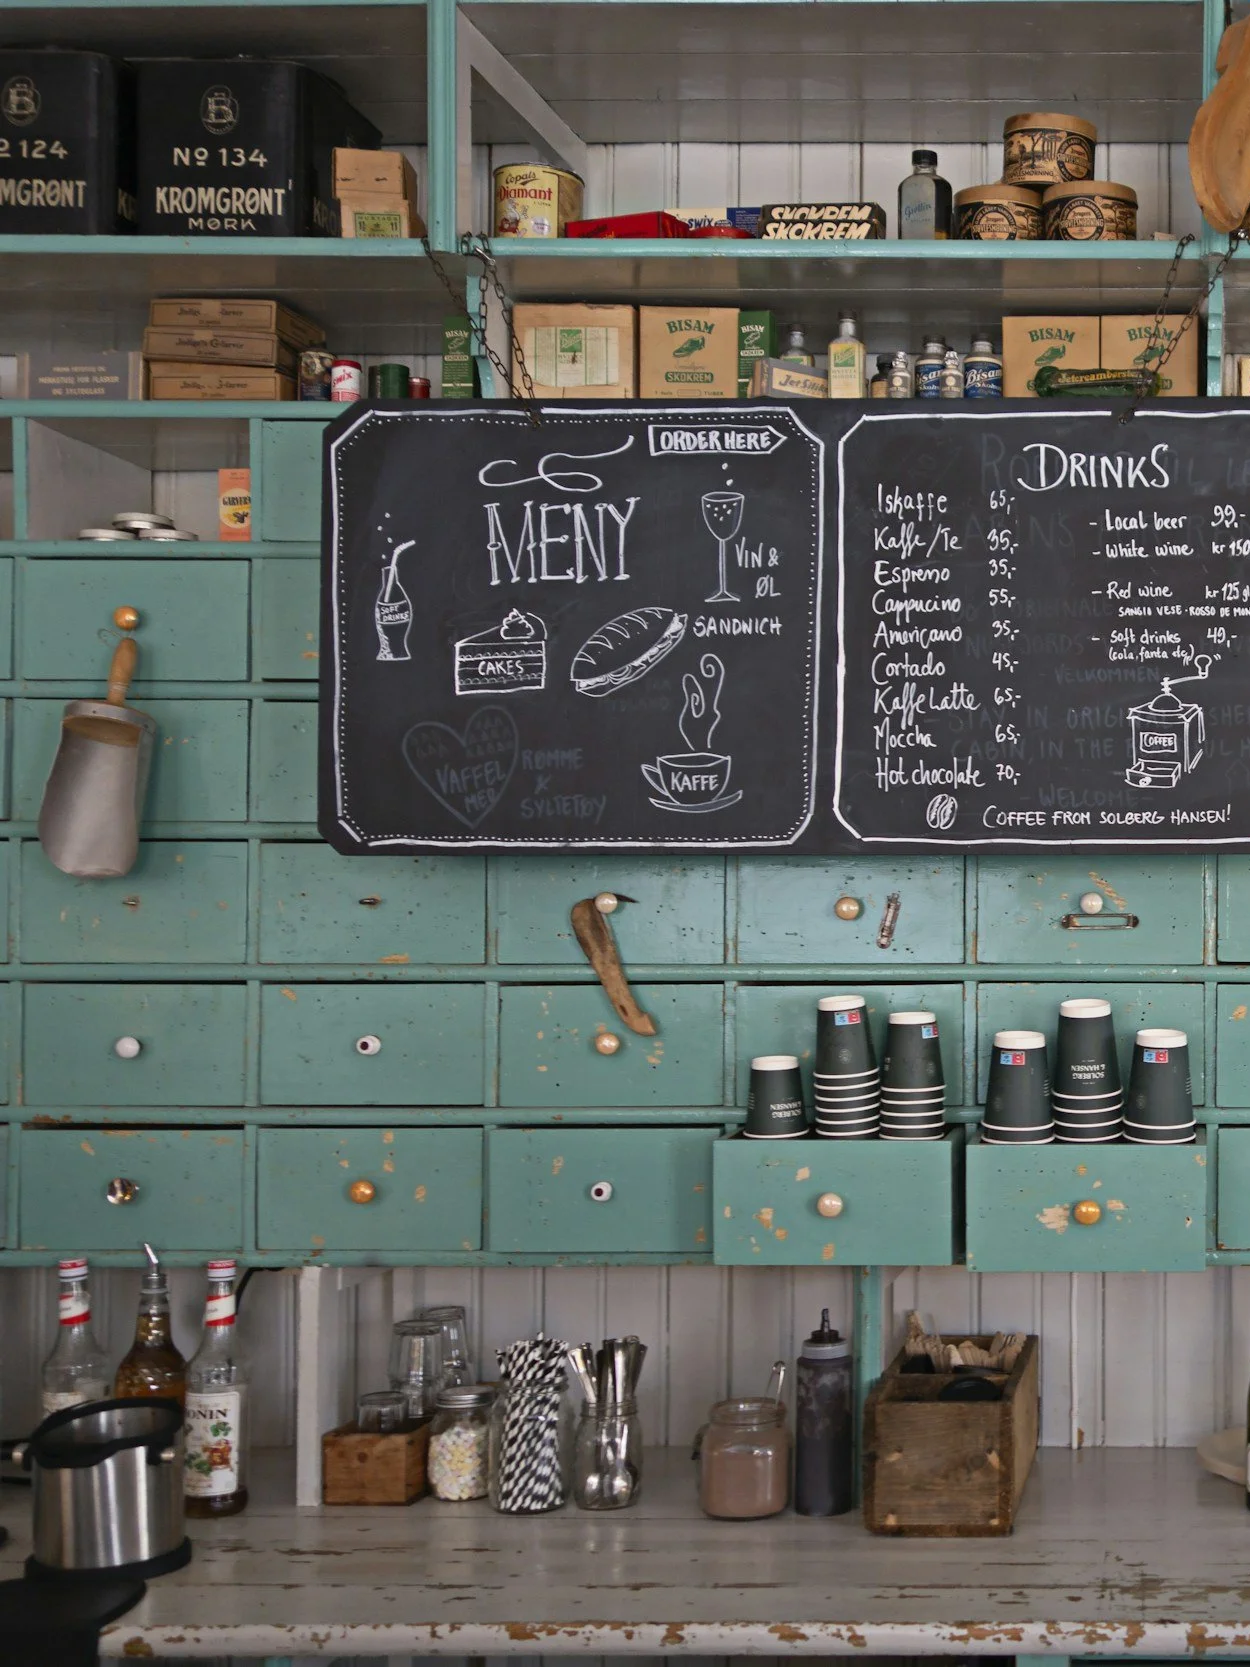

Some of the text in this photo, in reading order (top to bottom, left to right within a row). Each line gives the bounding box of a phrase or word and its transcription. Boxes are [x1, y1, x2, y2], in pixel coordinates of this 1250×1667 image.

[19, 140, 68, 159] 124
[218, 147, 268, 168] 134
[0, 178, 87, 208] MGRØNT
[155, 186, 286, 216] KROMGRØNT
[498, 185, 553, 201] Diamant
[762, 221, 873, 240] SKOKREM
[666, 319, 716, 334] BISAM
[740, 325, 765, 333] BISAM
[1028, 328, 1076, 343] BISAM
[1126, 327, 1174, 342] BISAM
[667, 372, 711, 383] SKOKREM
[659, 430, 772, 452] ORDER HERE
[1016, 443, 1170, 492] DRINKS
[1105, 508, 1148, 532] Local
[1153, 511, 1188, 531] beer
[483, 496, 641, 586] MENY
[1105, 538, 1149, 559] White
[1154, 541, 1195, 557] wine
[1211, 541, 1226, 555] kr
[735, 536, 779, 569] VIN &
[754, 574, 781, 599] ØL
[1106, 580, 1132, 600] Red
[1137, 581, 1173, 598] wine
[1205, 585, 1220, 600] kr
[1221, 581, 1240, 601] 125
[380, 605, 400, 617] SOFT
[382, 611, 410, 622] DRINKS
[1155, 604, 1183, 616] VESE
[1188, 605, 1217, 617] ROSSO
[1219, 606, 1231, 618] DE
[1109, 627, 1136, 646] Soft
[1139, 628, 1182, 645] drinks
[1138, 647, 1169, 663] fanta
[477, 659, 524, 679] CAKES
[871, 651, 946, 688] Cortado
[873, 714, 938, 756] Moccha
[671, 771, 719, 793] KAFFE
[874, 756, 909, 793] Hot
[911, 755, 986, 790] chocolate
[982, 803, 1231, 829] COFFEE FROM SOLBERG HANSEN!
[1071, 1064, 1099, 1072] HANSEN
[1072, 1071, 1106, 1080] SOLBERG
[186, 1408, 230, 1419] ONIN
